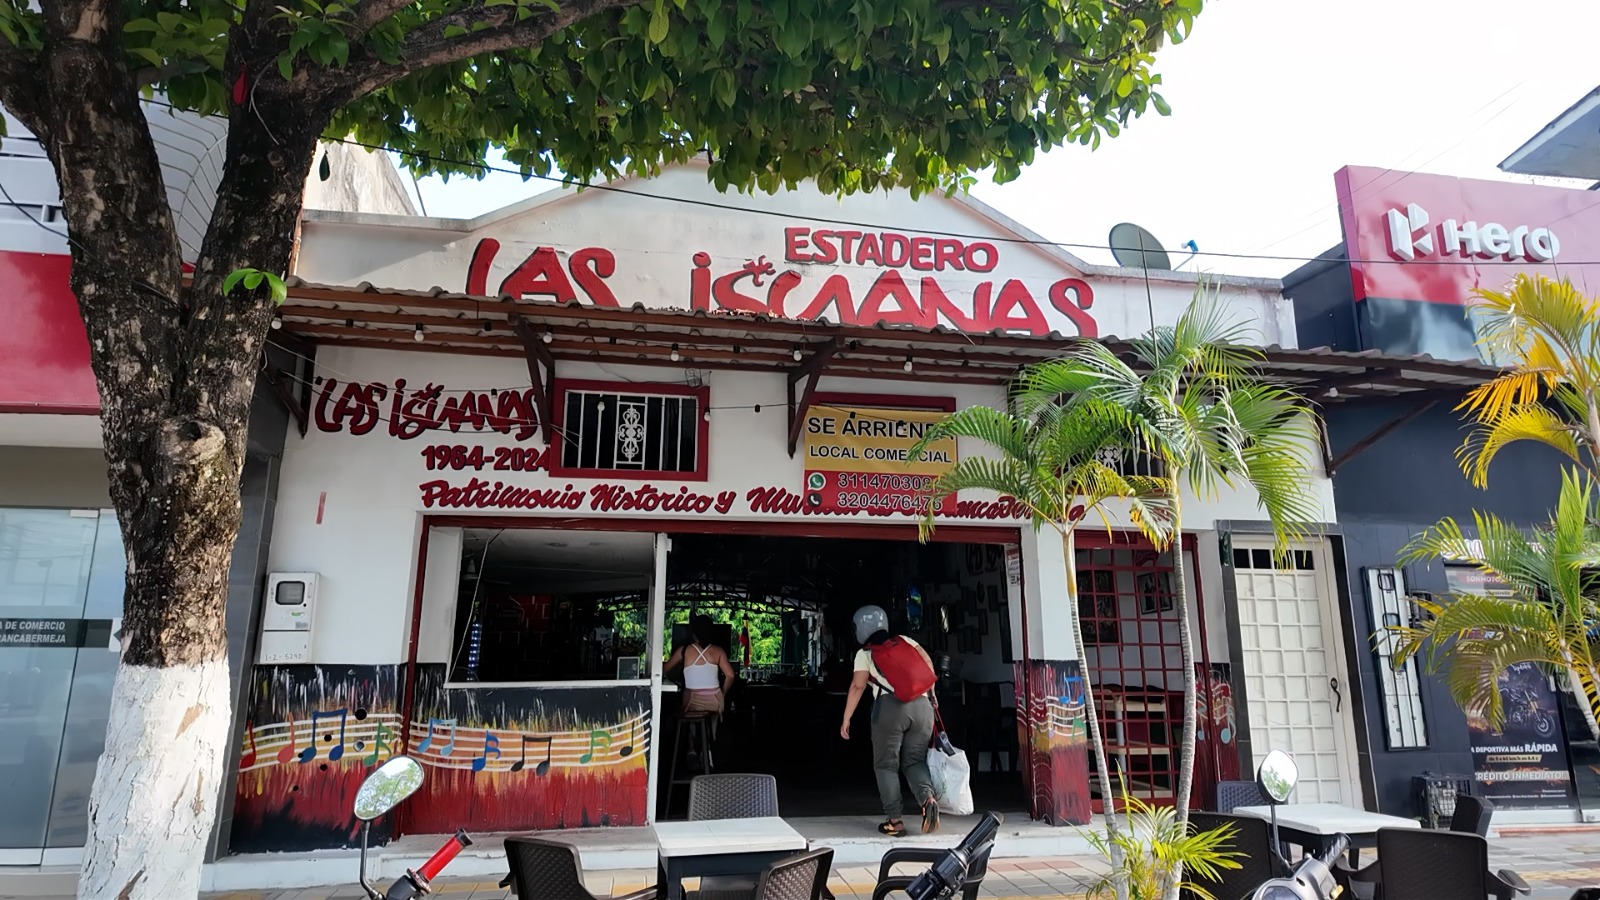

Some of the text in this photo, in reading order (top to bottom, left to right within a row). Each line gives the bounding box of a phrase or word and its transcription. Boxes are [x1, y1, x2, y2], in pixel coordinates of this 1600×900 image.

[784, 227, 999, 273] ESTADERO
[1437, 218, 1561, 263] Hero
[465, 237, 621, 308] LAS
[314, 378, 387, 436] LAS
[807, 417, 954, 441] SE ARRIEN
[420, 444, 551, 472] 1964-2024
[810, 445, 953, 464] LOCAL COMECIAL
[837, 473, 943, 493] 311470308
[836, 493, 944, 512] 3204476476
[5, 621, 18, 630] DE
[19, 621, 66, 631] COMERCIO
[0, 633, 67, 644] ANCABERMEJA
[1524, 742, 1558, 753] RÁPIDA
